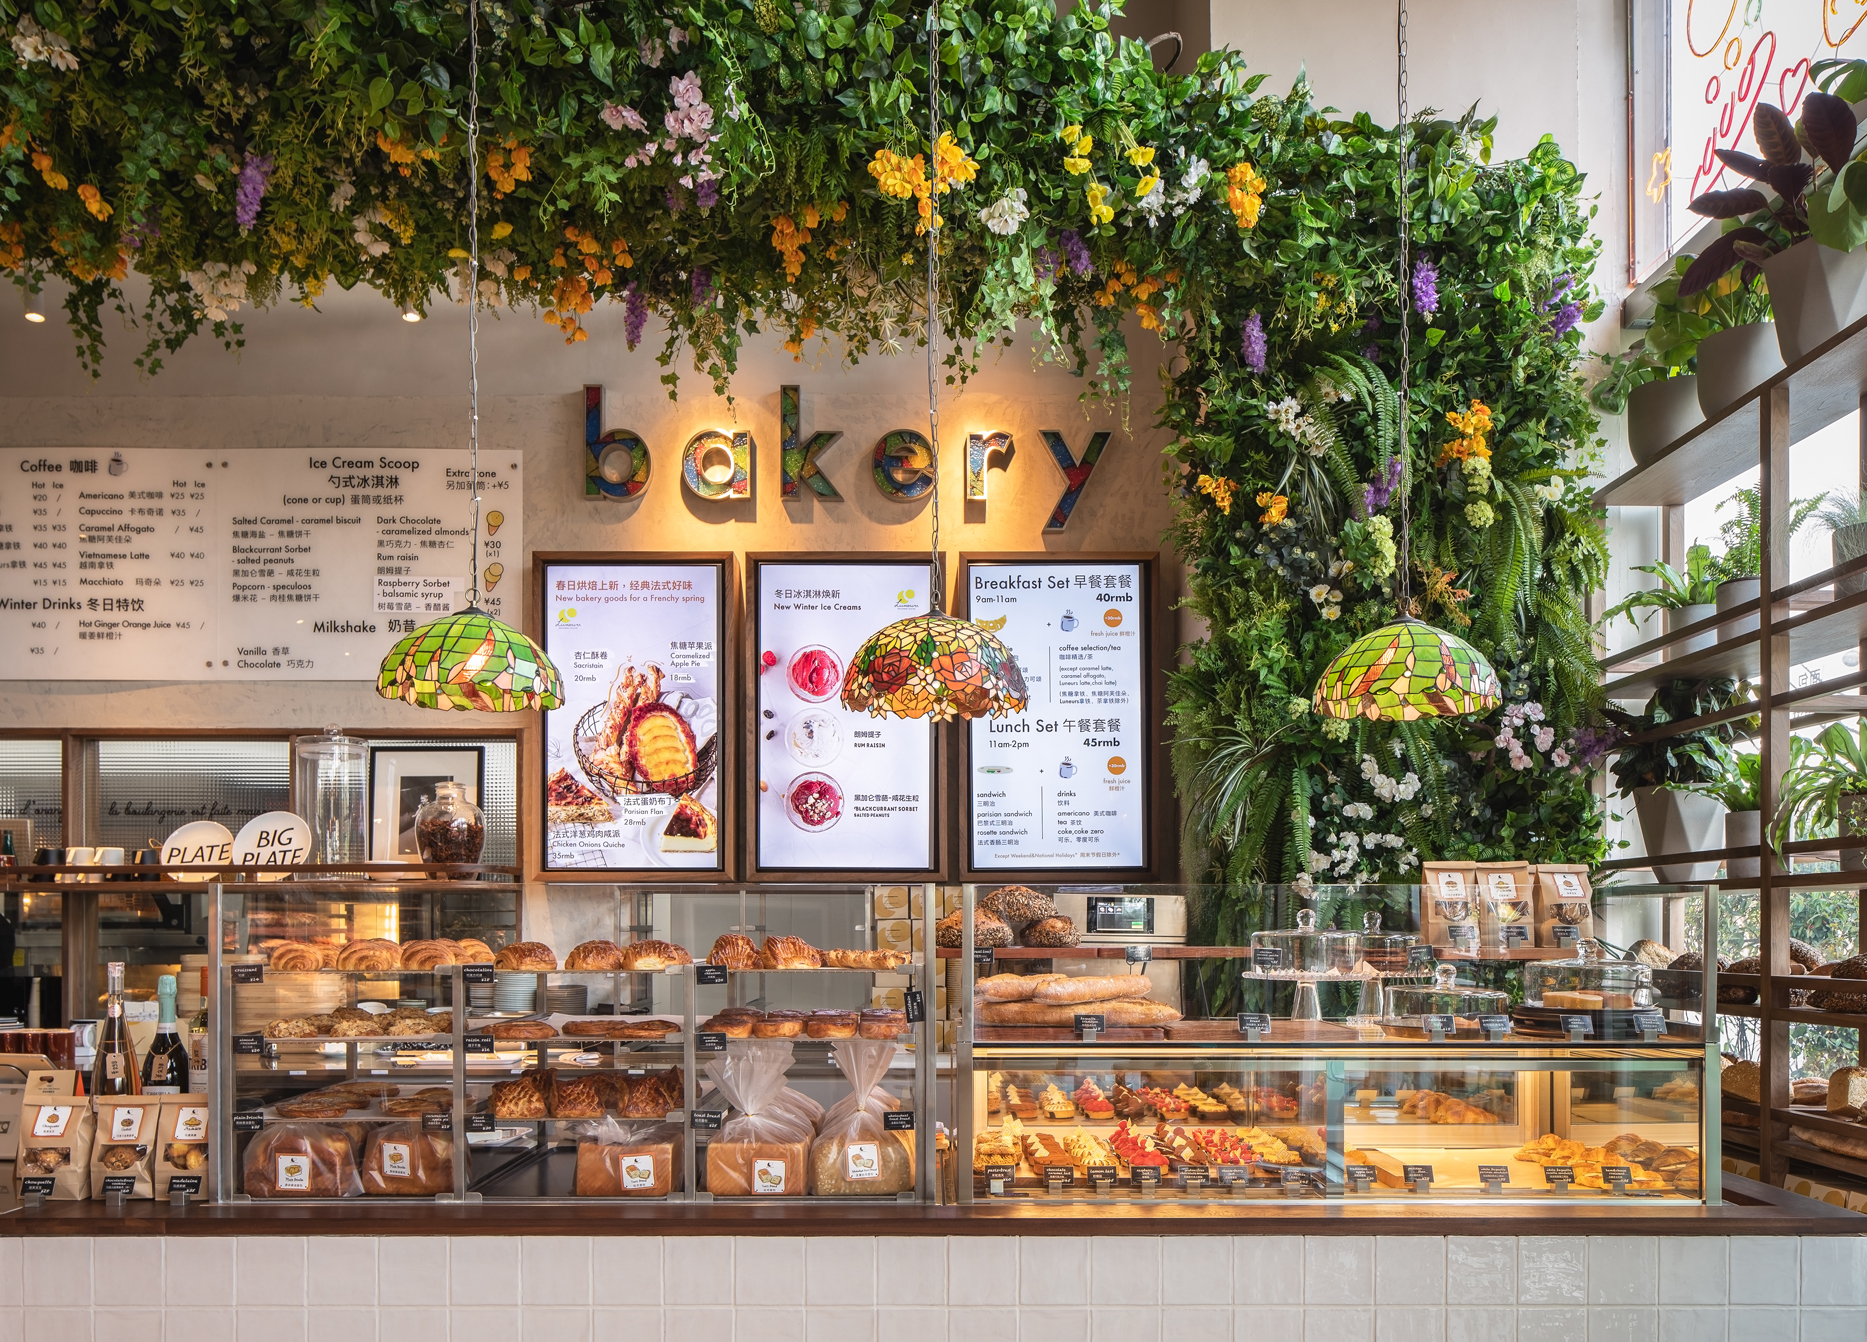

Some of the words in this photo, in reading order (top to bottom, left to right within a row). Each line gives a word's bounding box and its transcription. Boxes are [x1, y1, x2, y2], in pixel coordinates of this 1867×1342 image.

[583, 383, 1114, 534] bakery
[20, 460, 63, 473] Coffee
[70, 460, 98, 473] 咖啡
[309, 457, 326, 469] Ice
[332, 457, 374, 470] Cream
[378, 457, 420, 472] Scoop
[328, 475, 400, 489] 勺式冰淇淋
[78, 492, 124, 500] Americano
[128, 491, 164, 500] 美式咖啡
[283, 494, 308, 506] (cone
[312, 496, 322, 504] or
[324, 494, 346, 506] cup)
[350, 494, 404, 506] 蛋筒或纸杯
[78, 507, 123, 516] Capuccino
[128, 508, 164, 516] 卡布奇诺
[232, 516, 257, 525] Salted
[260, 516, 294, 525] Caramel
[300, 516, 333, 524] caramel
[336, 516, 361, 524] biscuit
[376, 516, 396, 524] Dark
[399, 516, 441, 524] Chocolate
[78, 524, 115, 533] Caramel
[117, 524, 155, 534] Affogato
[382, 528, 432, 536] caramelized
[434, 528, 469, 536] almonds
[232, 530, 266, 539] 焦糖海盐
[278, 530, 312, 538] 焦糖饼干
[232, 544, 283, 554] Blackcurrant
[284, 545, 311, 554] Sorbet
[376, 540, 411, 548] 黑巧克力
[420, 540, 454, 549] 焦糖杏仁
[484, 540, 502, 549] ¥30
[78, 551, 127, 560] Vietnamese
[130, 551, 150, 560] Latte
[376, 553, 394, 562] Rum
[397, 553, 418, 562] raisin
[79, 561, 114, 570] 越南拿铁
[236, 556, 261, 564] salted
[263, 556, 294, 566] peanuts
[377, 566, 412, 576] 朗姆提子
[79, 578, 124, 586] Macchiato
[135, 578, 162, 587] 玛奇朵
[377, 579, 420, 589] Raspberry
[422, 580, 450, 588] Sorbet
[556, 580, 692, 591] 春日烘焙上新，经典法式好味
[975, 575, 1042, 589] Breakfast
[1048, 576, 1070, 589] Set
[1074, 574, 1132, 589] 早餐套餐
[232, 582, 266, 592] Popcorn
[272, 582, 312, 592] speculoos
[232, 594, 258, 602] 爆米花
[382, 590, 418, 599] balsamic
[421, 591, 444, 600] syrup
[576, 595, 601, 603] bakery
[604, 595, 627, 603] goods
[650, 595, 679, 603] Frenchy
[682, 595, 705, 603] spring
[775, 589, 840, 599] 冬日冰淇淋焕新
[976, 595, 1017, 603] 9am-11am
[1096, 593, 1133, 603] 40rmb
[42, 597, 82, 610] Drinks
[86, 598, 145, 612] 冬日特饮
[377, 602, 412, 612] 树莓雪葩
[78, 620, 92, 628] Hot
[94, 621, 120, 630] Ginger
[122, 621, 151, 630] Orange
[153, 620, 171, 629] Juice
[313, 620, 376, 634] Milkshake
[388, 620, 416, 633] 奶昔
[670, 641, 712, 650] 焦糖苹果派
[237, 647, 267, 656] Vanilla
[272, 646, 290, 656] 香草
[574, 651, 607, 660] 杏仁酥卷
[237, 660, 282, 669] Chocolate
[286, 660, 314, 669] 巧克力
[989, 719, 1030, 733] Lunch
[1036, 719, 1058, 732] Set
[1063, 718, 1121, 733] 午餐套餐
[989, 740, 1029, 749] 11am-2pm
[1083, 738, 1120, 747] 45rmb
[623, 797, 672, 806] 法式蛋奶布丁
[109, 801, 119, 815] la
[125, 801, 186, 824] boulangerie
[191, 804, 206, 815] est
[208, 801, 232, 821] faite
[257, 827, 294, 848] BIG
[166, 843, 232, 864] PLATE
[242, 848, 303, 865] PLATE
